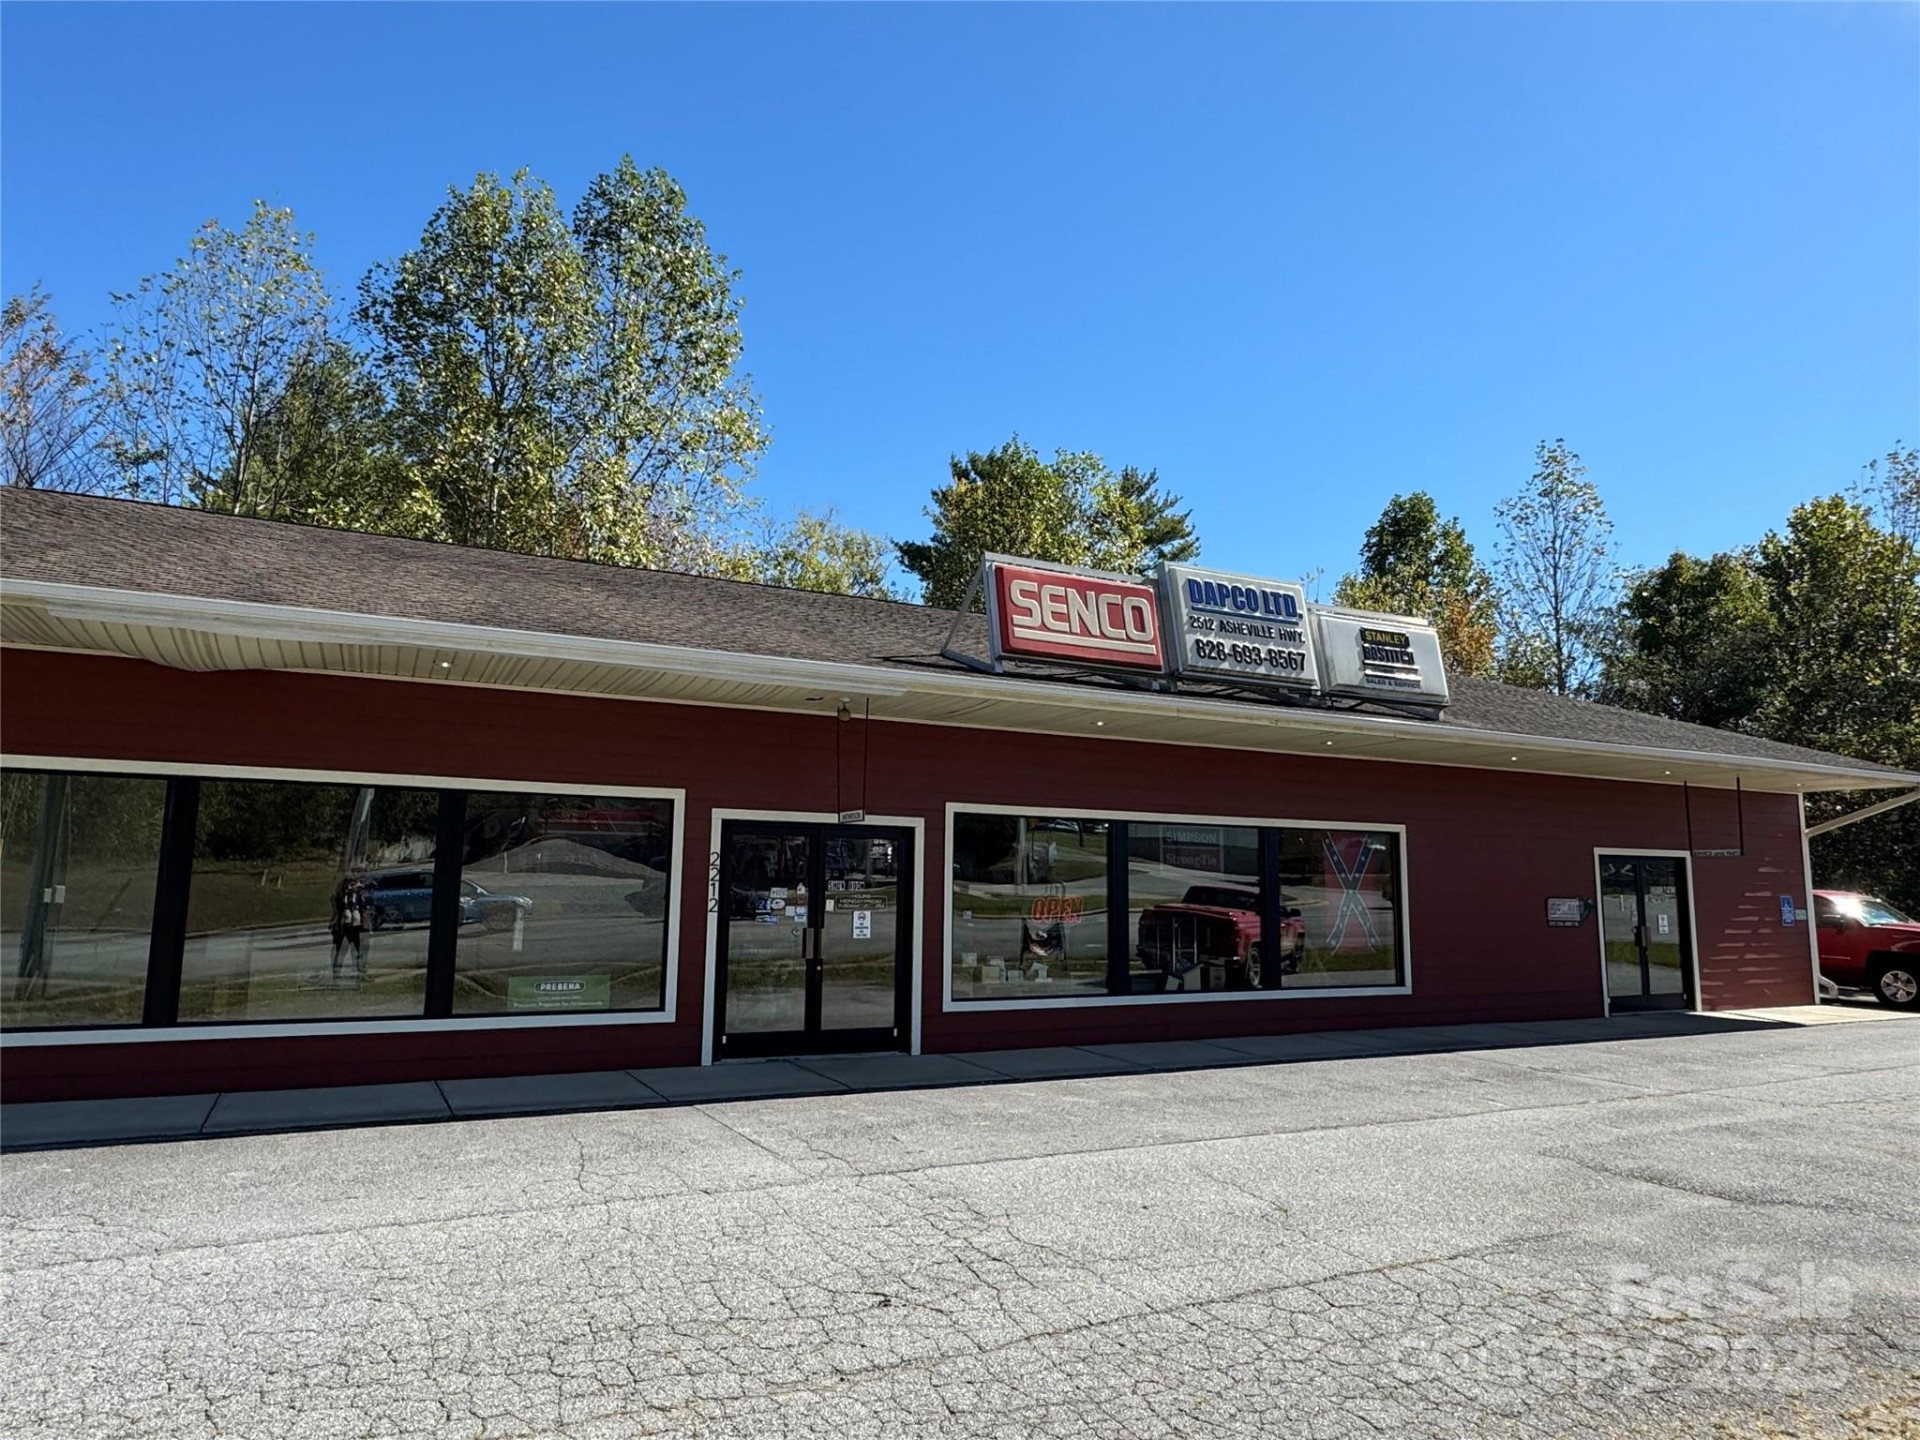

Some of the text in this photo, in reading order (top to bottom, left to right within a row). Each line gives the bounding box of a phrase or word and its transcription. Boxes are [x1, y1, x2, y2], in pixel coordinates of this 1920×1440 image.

[1010, 579, 1154, 641] SENCO
[1187, 578, 1259, 612] DAPCO
[1189, 615, 1216, 631] 2512
[1219, 619, 1276, 640] ASHEVILLE
[1364, 631, 1406, 645] STANLEY
[1195, 639, 1306, 671] 828-693-8567
[709, 851, 720, 913] 2212
[1031, 896, 1085, 924] OPEN
[540, 982, 581, 991] PREBENA
